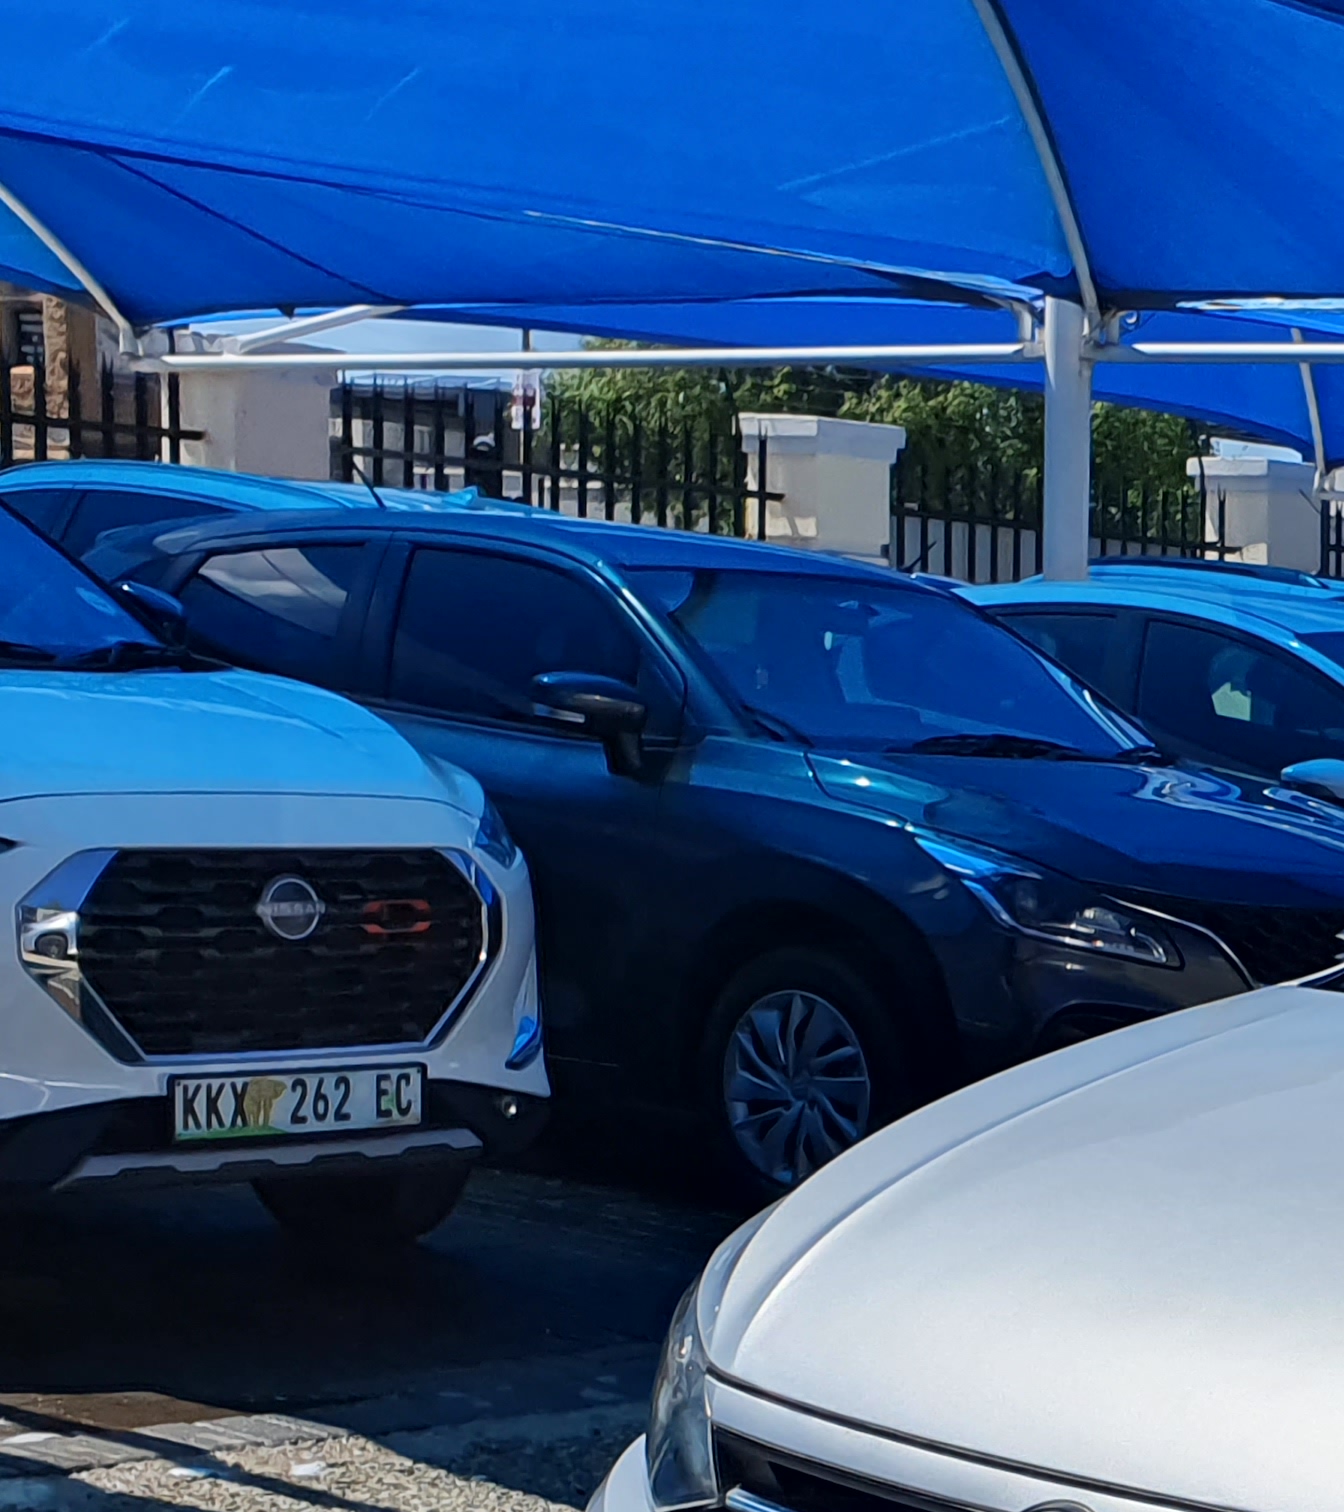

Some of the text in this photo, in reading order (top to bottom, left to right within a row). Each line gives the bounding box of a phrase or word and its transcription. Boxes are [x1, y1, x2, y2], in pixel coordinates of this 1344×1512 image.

[256, 901, 326, 917] NISSAN
[181, 1071, 412, 1131] KKX 262 EC
